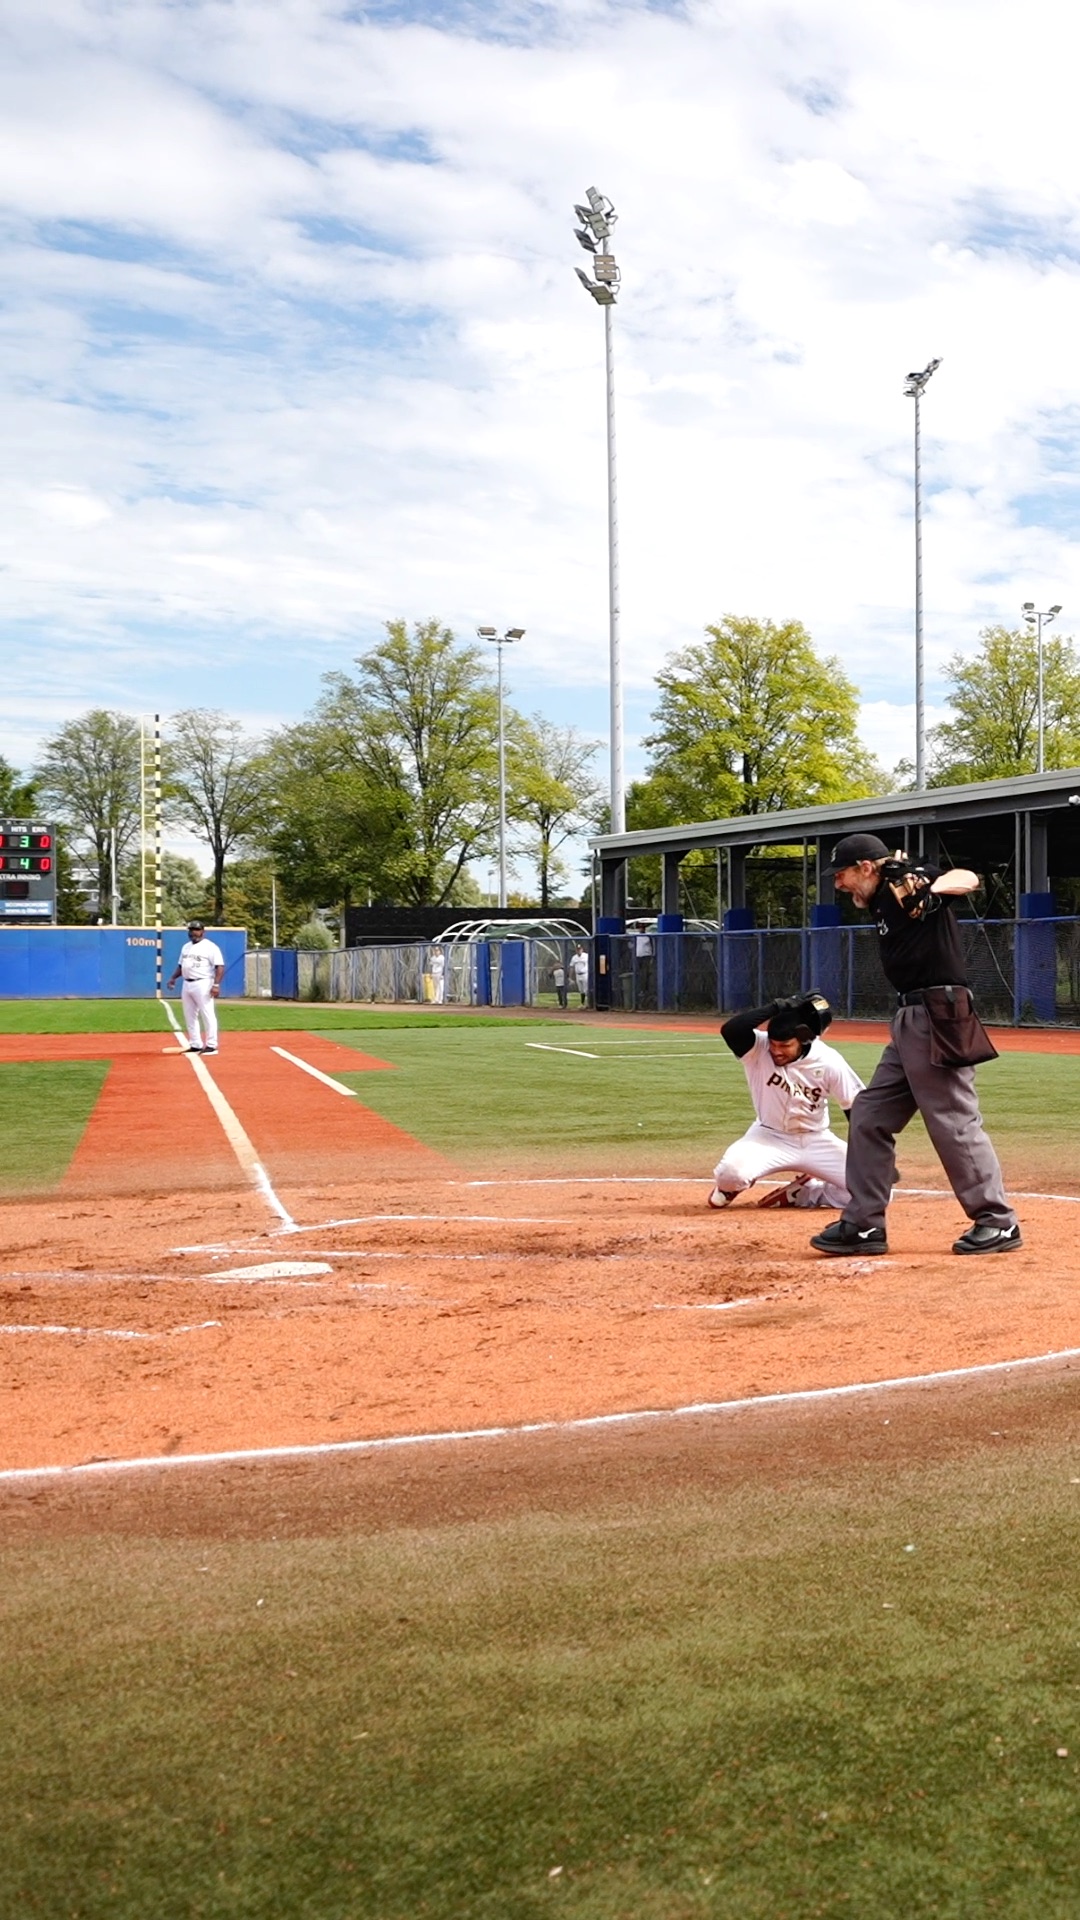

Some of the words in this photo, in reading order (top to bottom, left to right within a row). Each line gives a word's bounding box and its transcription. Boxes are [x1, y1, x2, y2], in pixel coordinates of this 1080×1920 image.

[20, 836, 29, 847] 3
[40, 836, 50, 848] 0
[20, 858, 29, 869] 4
[40, 858, 50, 870] 0
[126, 937, 155, 946] 100m
